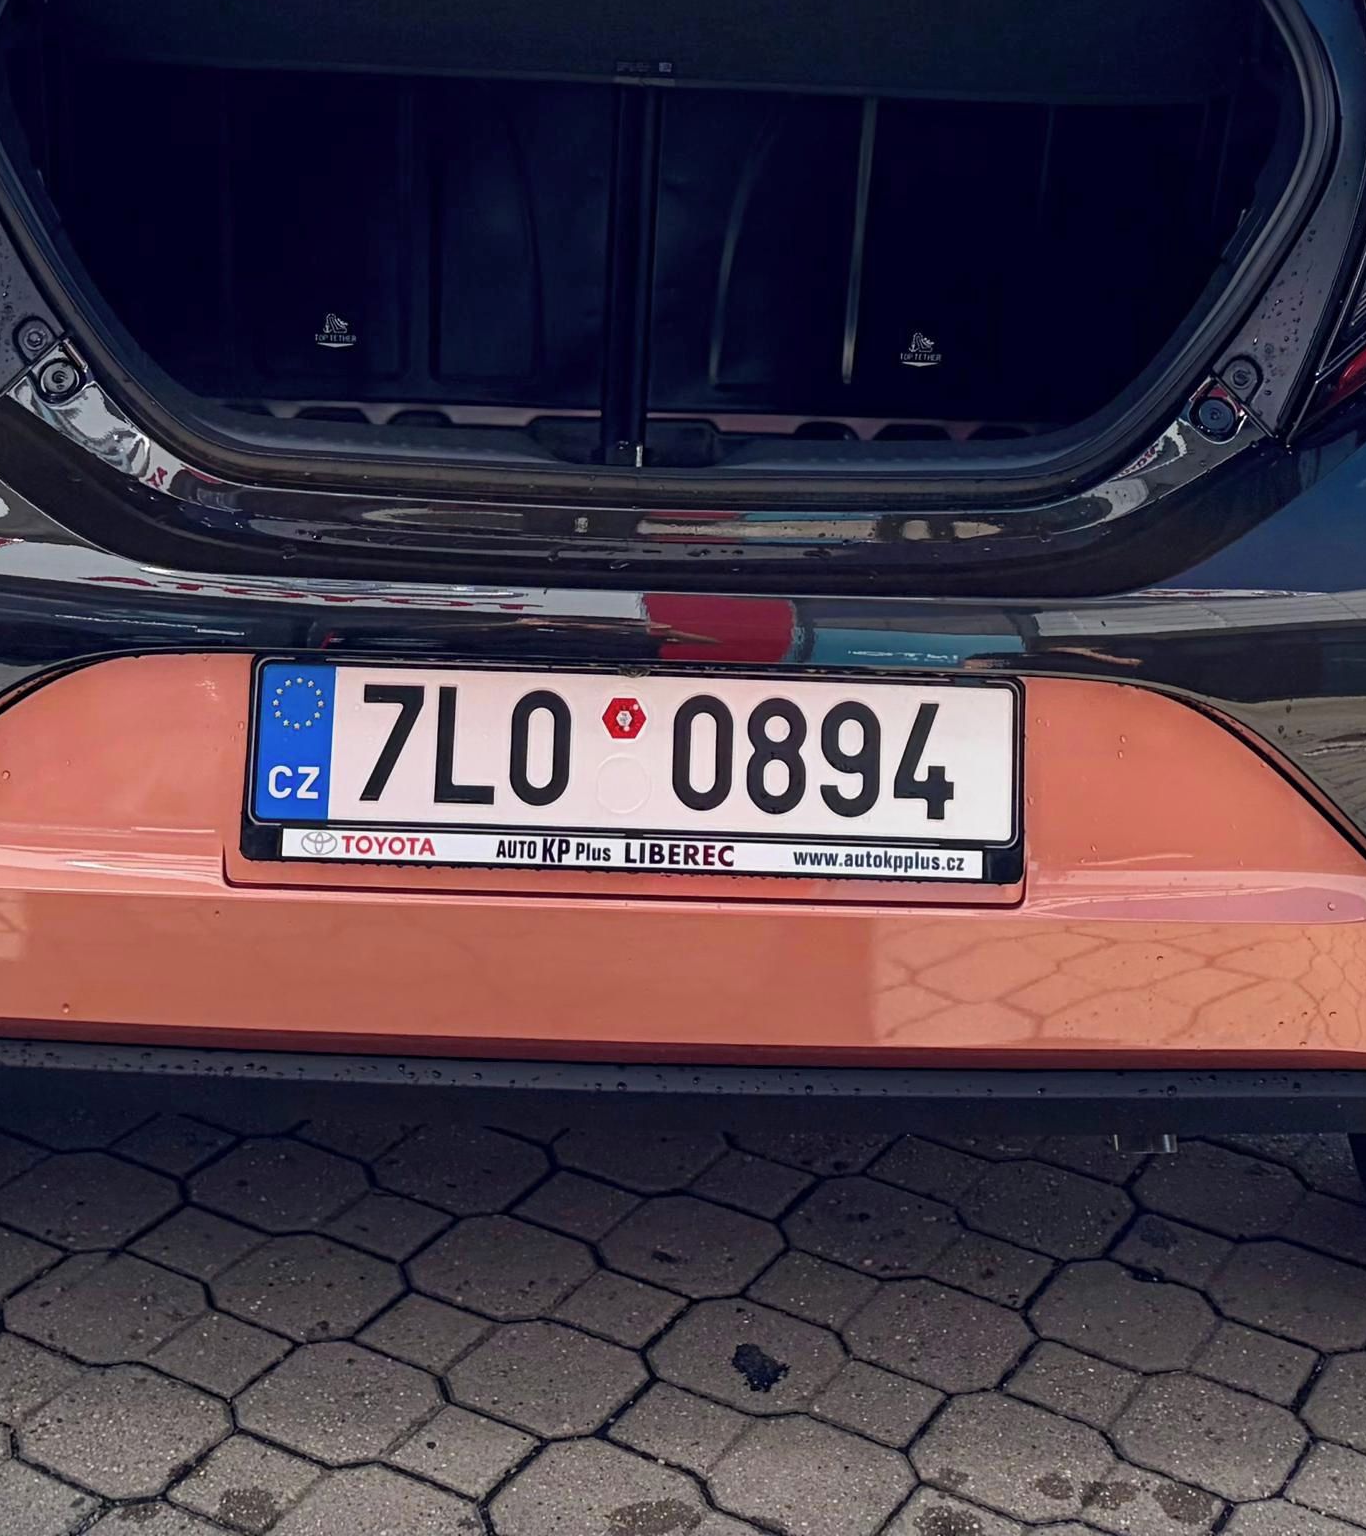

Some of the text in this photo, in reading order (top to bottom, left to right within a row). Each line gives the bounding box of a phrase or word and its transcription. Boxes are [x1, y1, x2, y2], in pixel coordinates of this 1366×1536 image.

[672, 694, 954, 820] 0894
[268, 765, 320, 800] CZ
[341, 835, 965, 874] TOYOTA AUTO KP Plus LIBEREC www.autokpplus.cz
